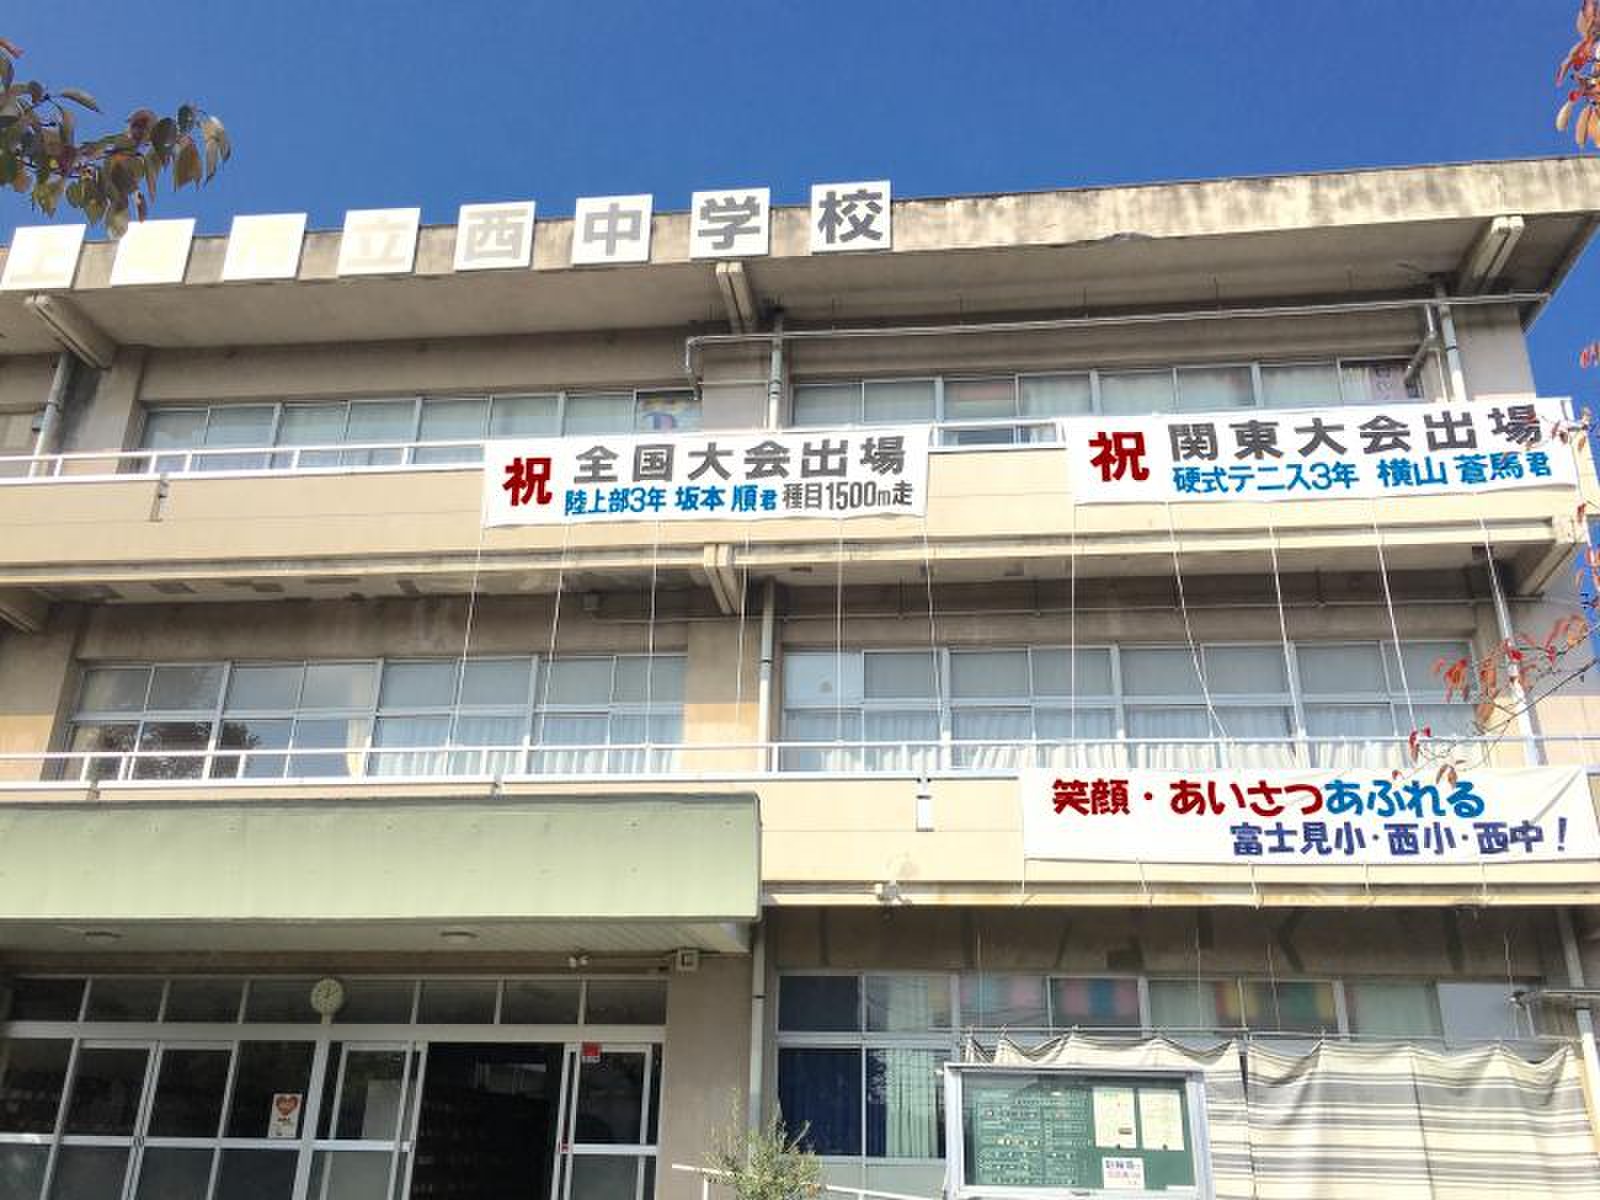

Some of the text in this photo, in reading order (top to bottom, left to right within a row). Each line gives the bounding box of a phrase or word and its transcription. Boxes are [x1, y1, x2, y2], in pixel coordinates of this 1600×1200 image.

[1168, 404, 1542, 461] 関東大会出場
[574, 436, 905, 484] 全国大会出場
[1089, 431, 1150, 483] 祝
[1172, 460, 1360, 494] 硬式テニス3年
[1376, 457, 1449, 488] 横山
[502, 457, 553, 507] 祝
[564, 486, 667, 516] 陸上部3年
[674, 485, 726, 512] 坂本
[783, 480, 914, 510] 種目1500m走
[1052, 779, 1485, 819] 笑顔・あいさつあふれる
